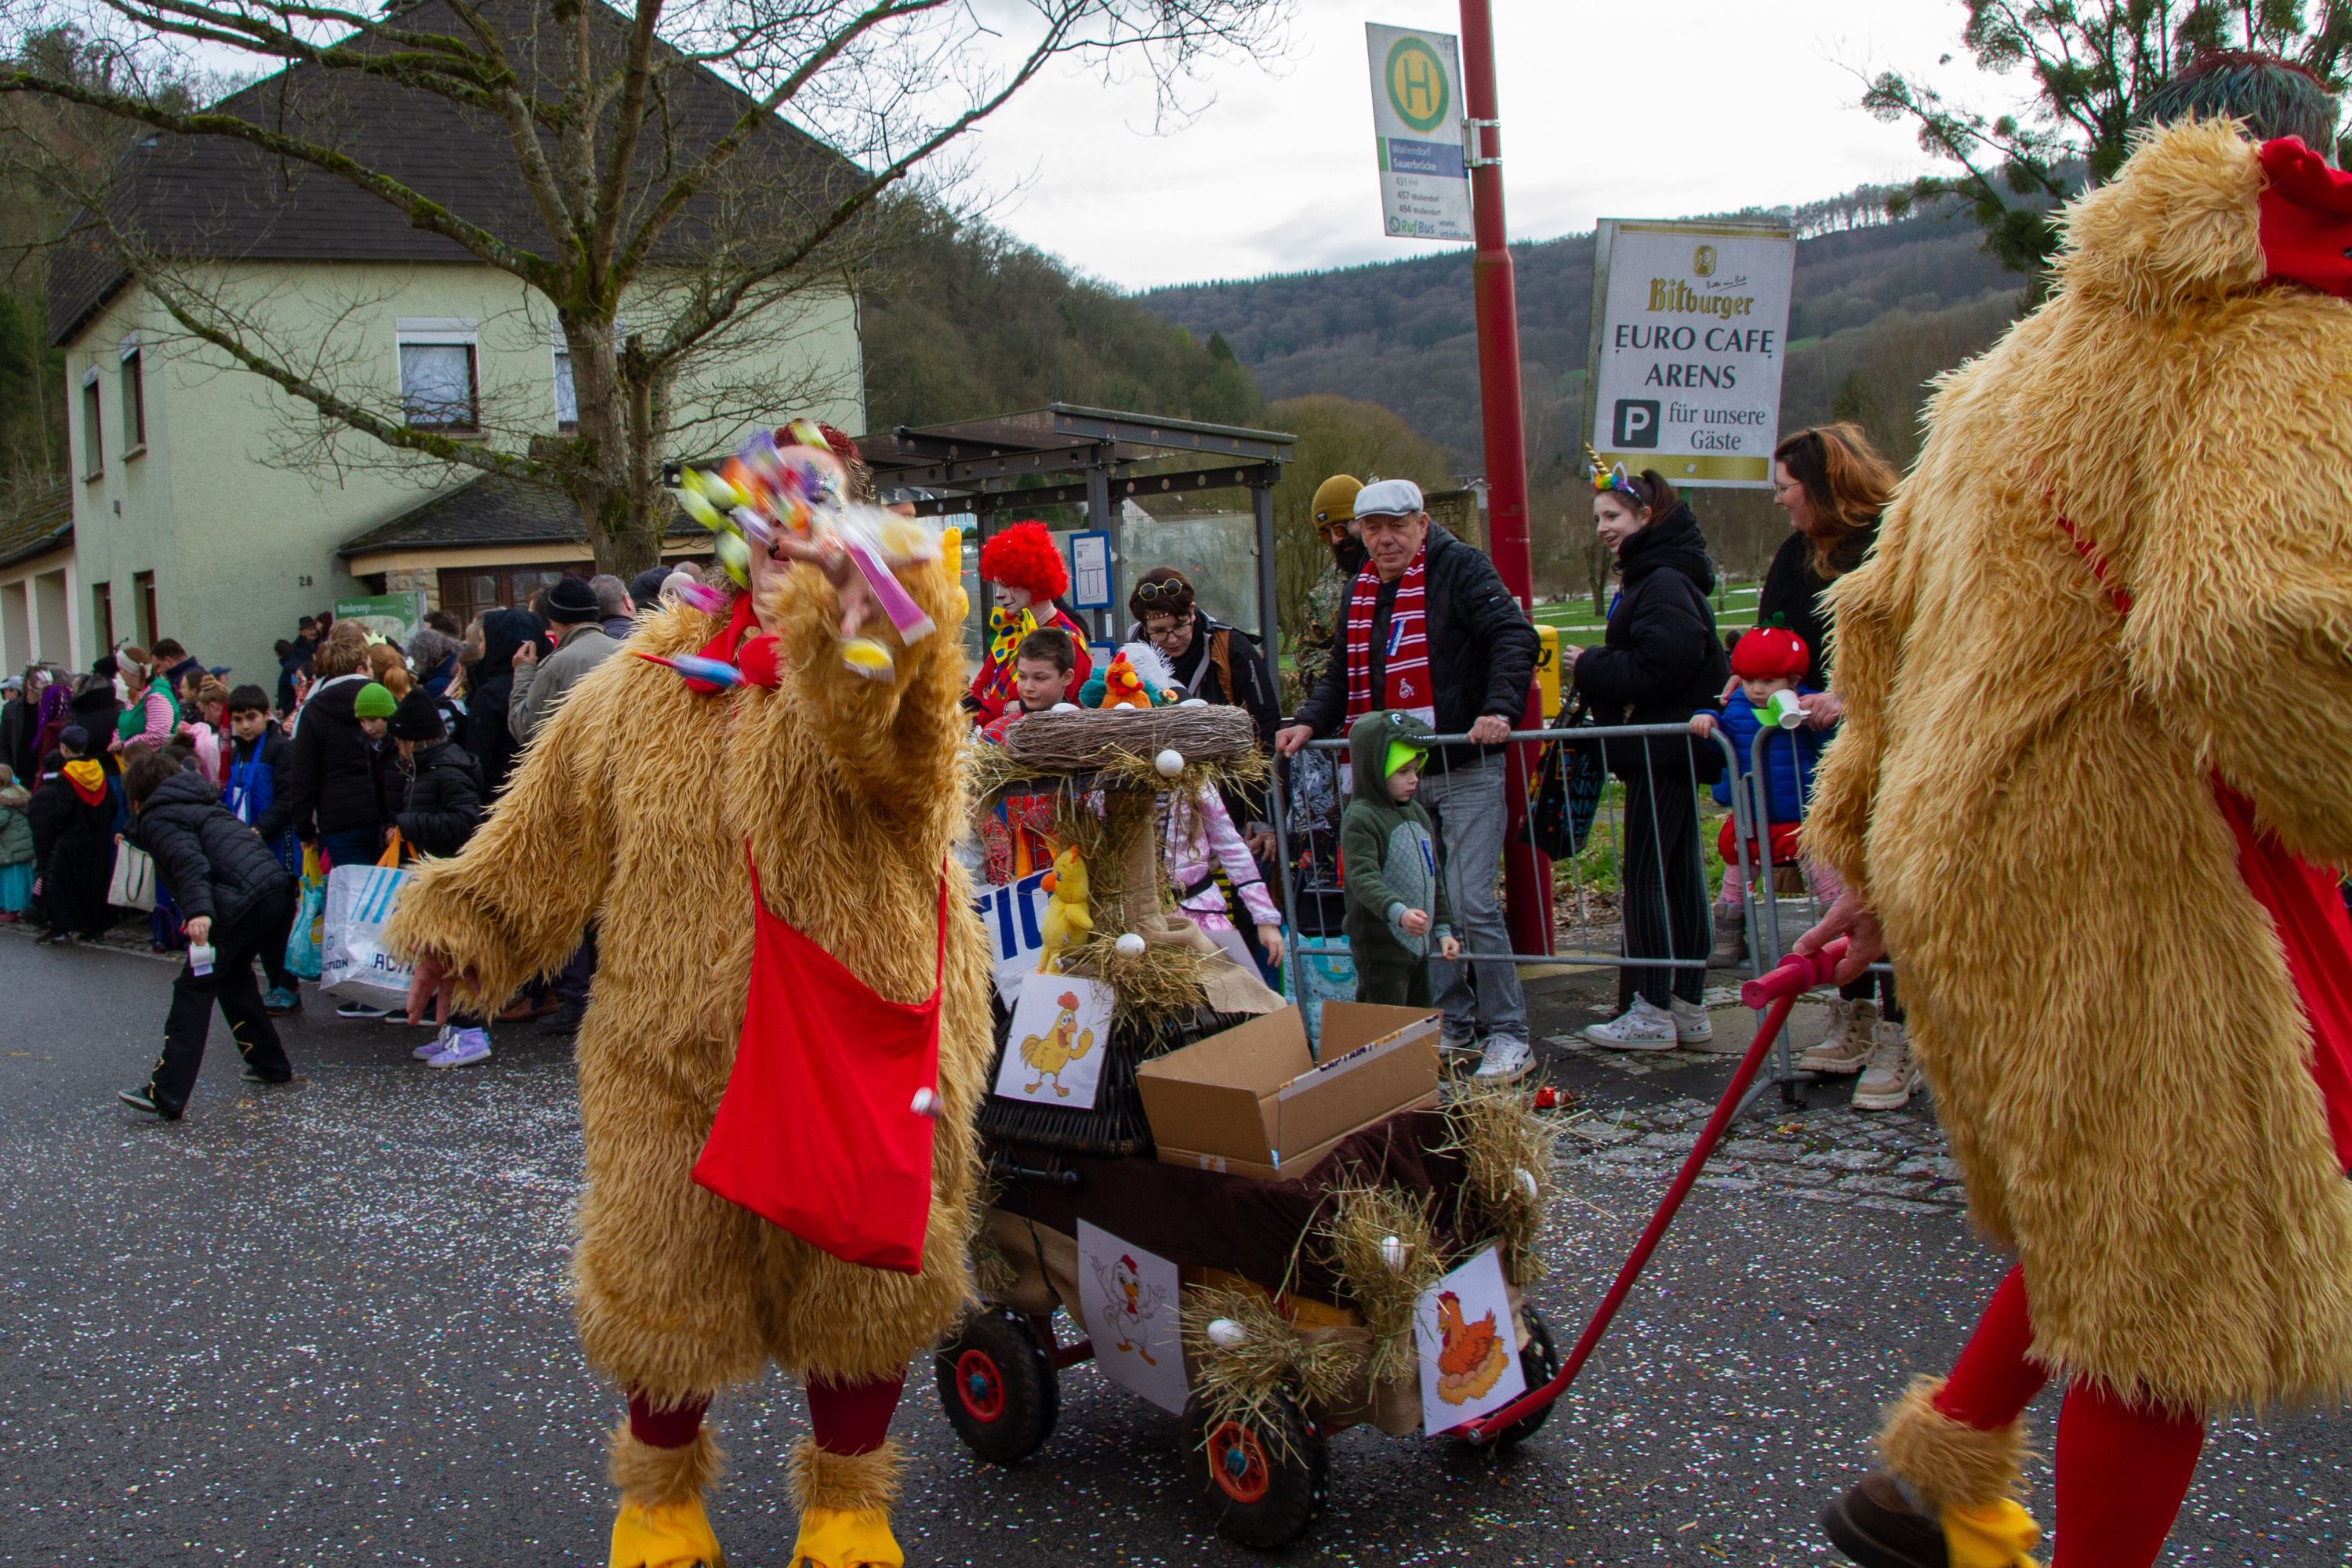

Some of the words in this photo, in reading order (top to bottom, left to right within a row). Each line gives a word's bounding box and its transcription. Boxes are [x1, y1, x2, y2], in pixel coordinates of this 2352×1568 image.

[1403, 57, 1432, 111] H
[1392, 143, 1431, 156] Wallendorf
[1397, 191, 1410, 200] 457
[1401, 220, 1435, 237] RufBus
[1646, 277, 1754, 320] Bitburger
[1615, 324, 1696, 350] EURO
[1704, 327, 1774, 353] CAFE
[1644, 363, 1737, 389] ARENS
[1624, 406, 1650, 441] P
[1668, 401, 1698, 423] für
[1704, 408, 1766, 425] unsere
[1690, 430, 1741, 451] Gäste
[299, 575, 313, 586] 28
